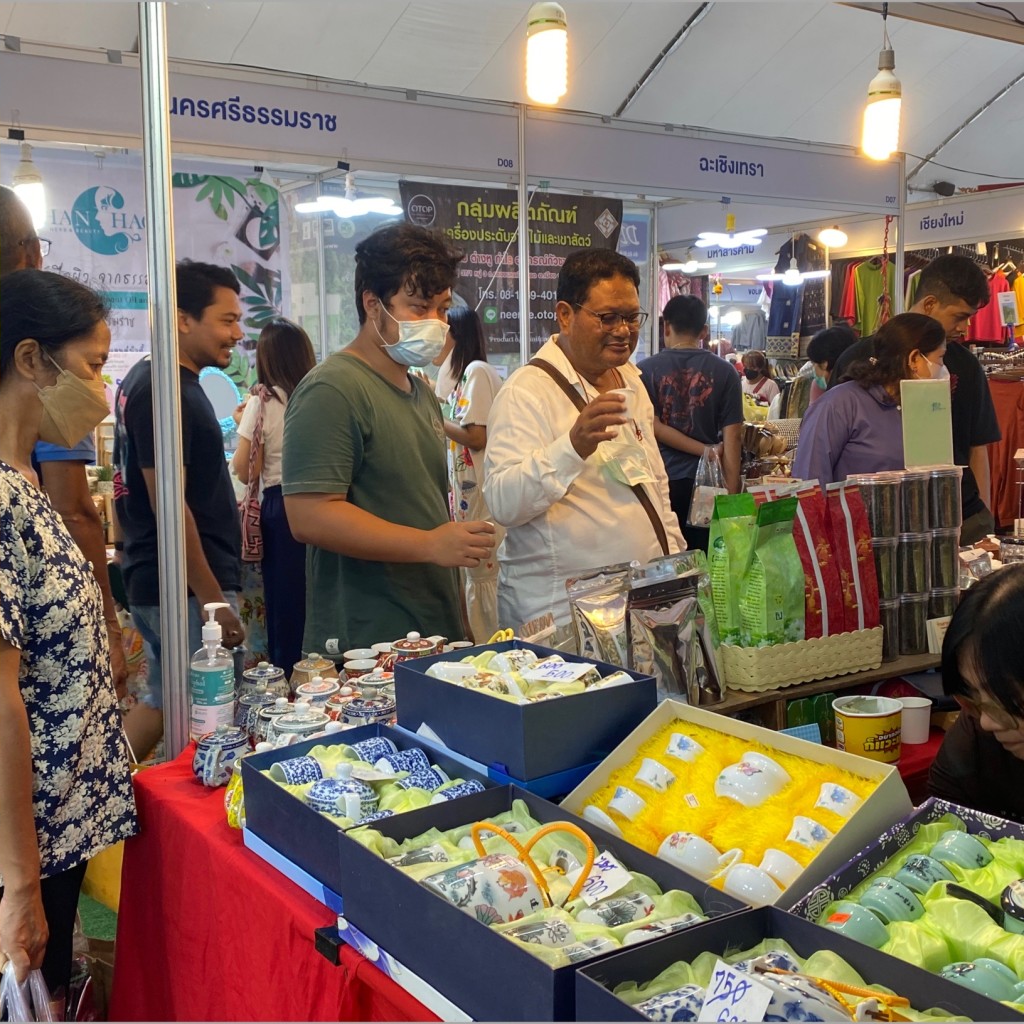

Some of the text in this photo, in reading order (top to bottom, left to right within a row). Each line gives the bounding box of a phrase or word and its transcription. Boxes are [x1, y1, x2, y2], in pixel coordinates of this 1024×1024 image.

[170, 96, 337, 132] นครศรีธรรมราช
[497, 158, 513, 168] D08
[699, 154, 764, 178] ฉะเชิงเทรา
[411, 205, 433, 214] OTOP
[920, 211, 964, 230] เชียงใหม่
